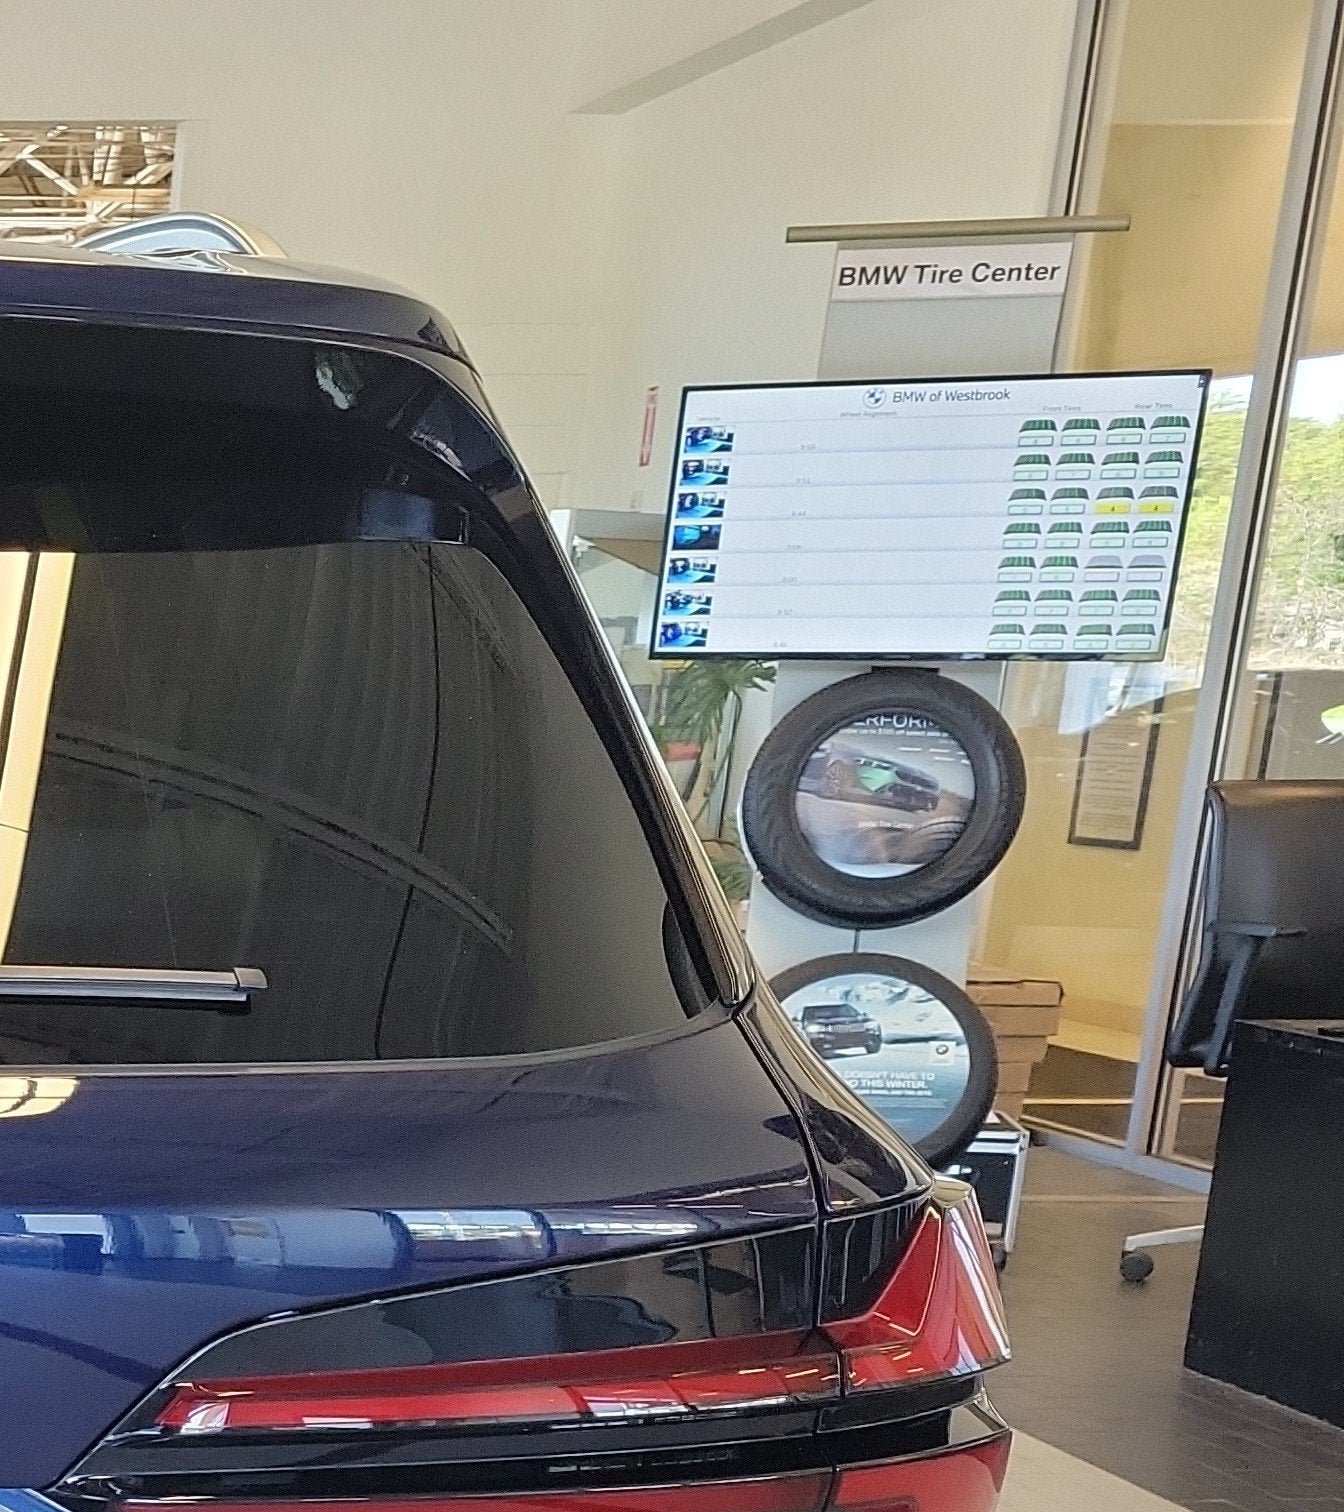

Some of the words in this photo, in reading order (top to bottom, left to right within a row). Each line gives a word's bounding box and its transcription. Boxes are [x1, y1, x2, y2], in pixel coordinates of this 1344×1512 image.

[838, 265, 909, 286] BMW
[914, 264, 963, 284] Tire
[972, 262, 1061, 283] Center
[892, 391, 927, 403] BMW
[929, 390, 944, 402] of
[945, 388, 1011, 401] Westbrook
[860, 1080, 884, 1088] THIS
